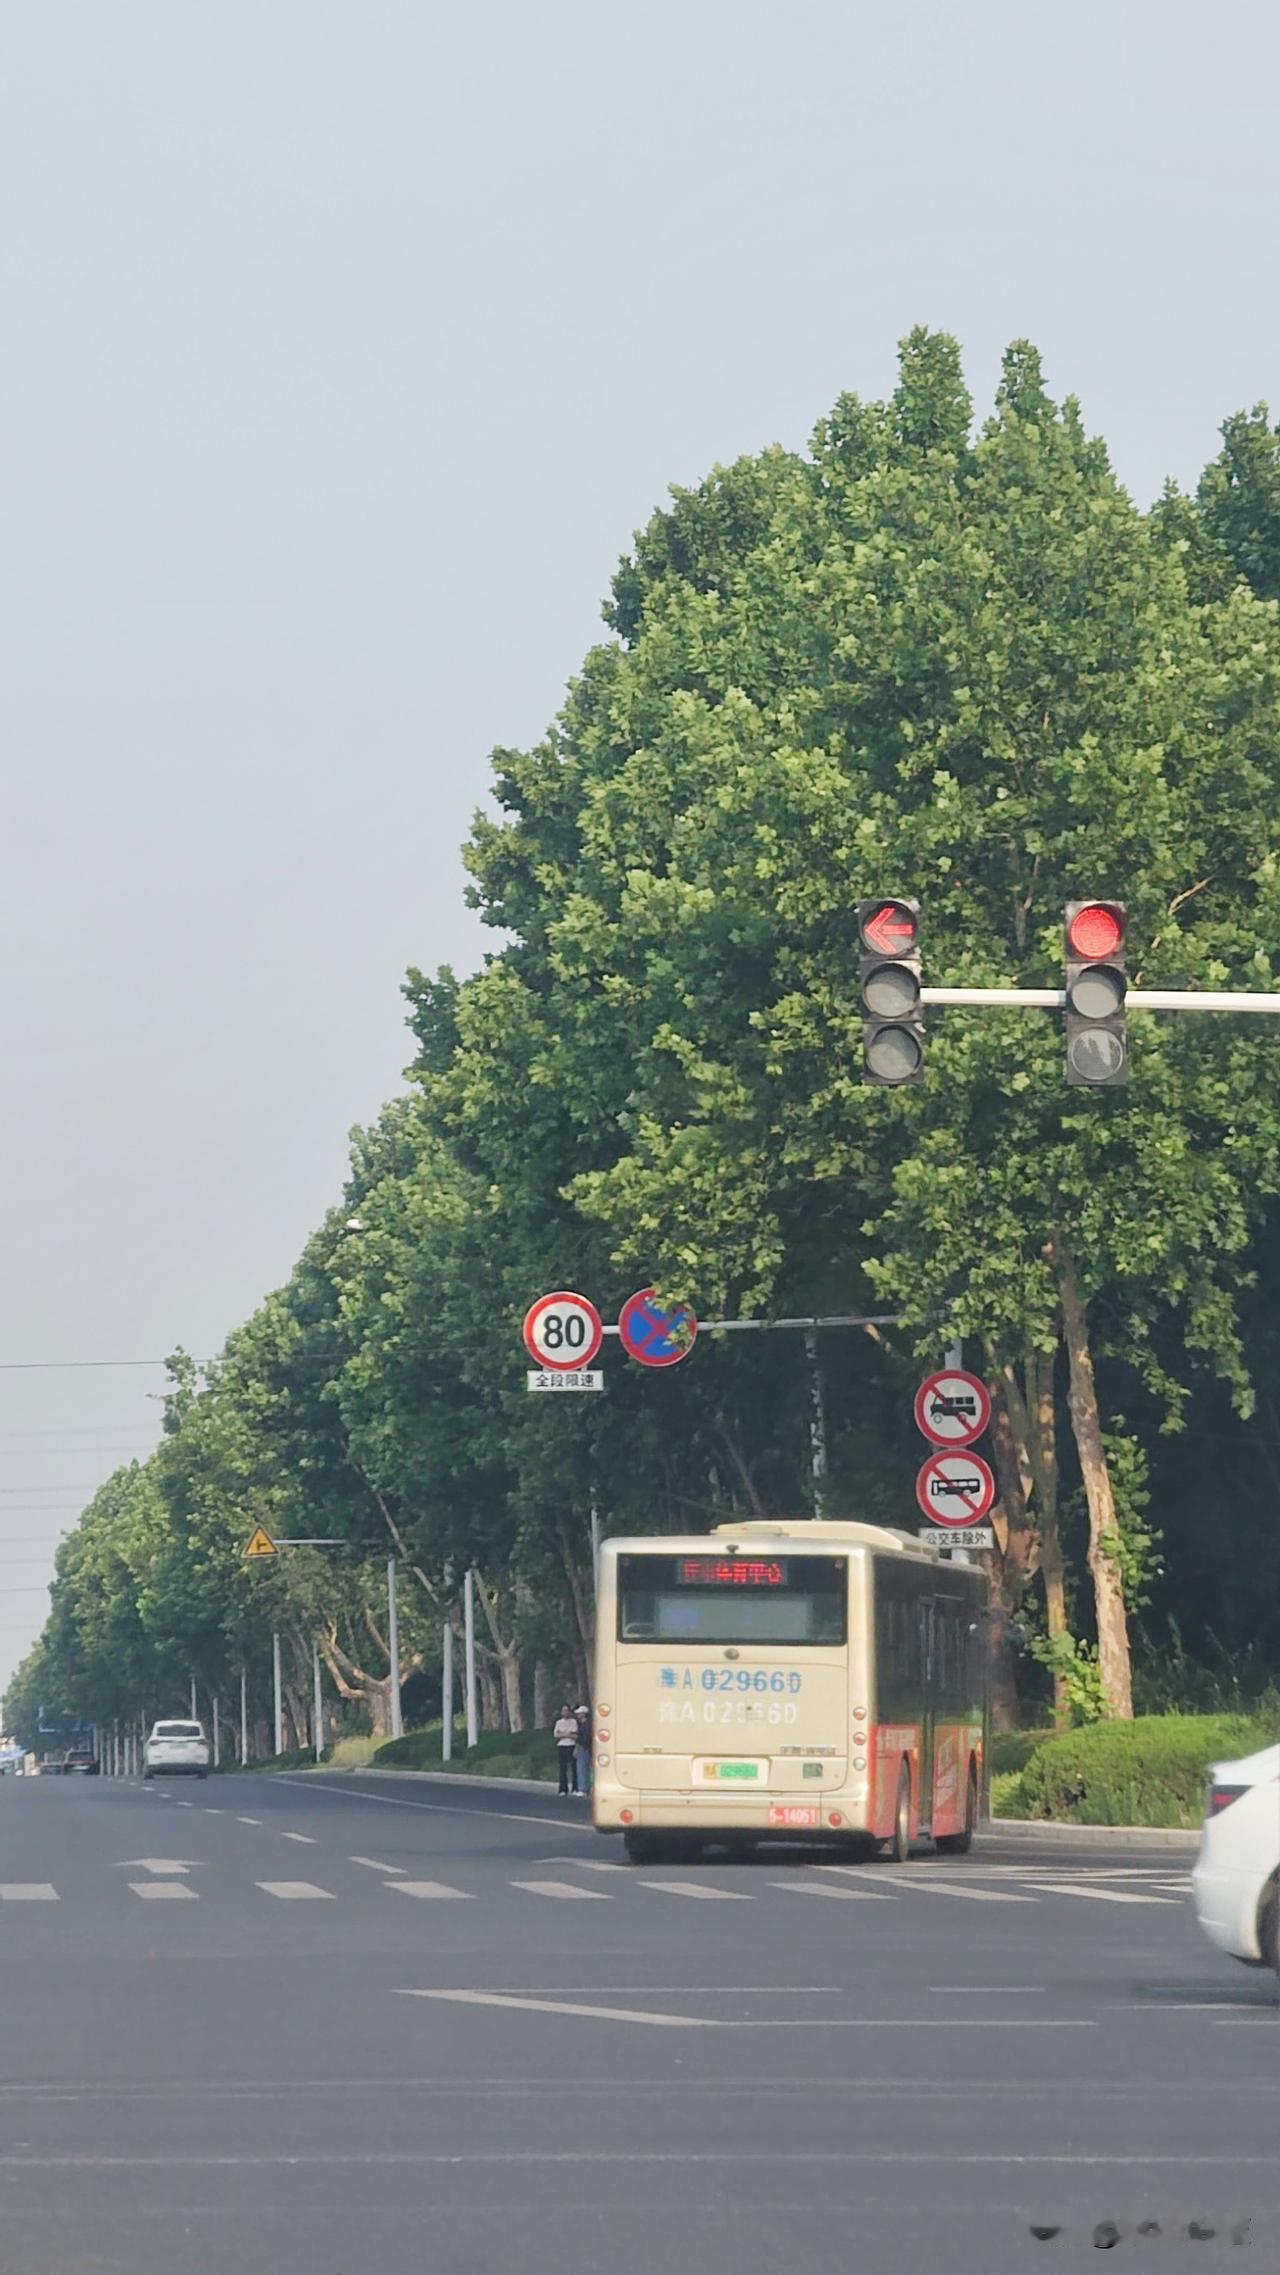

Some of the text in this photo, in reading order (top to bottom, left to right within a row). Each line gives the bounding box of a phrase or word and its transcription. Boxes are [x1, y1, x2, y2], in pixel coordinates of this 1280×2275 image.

[543, 1314, 585, 1349] 80
[535, 1373, 595, 1388] 全段限速
[926, 1530, 987, 1546] 公交车除外
[659, 1667, 803, 1694] A02966D
[658, 1700, 798, 1725] A026D
